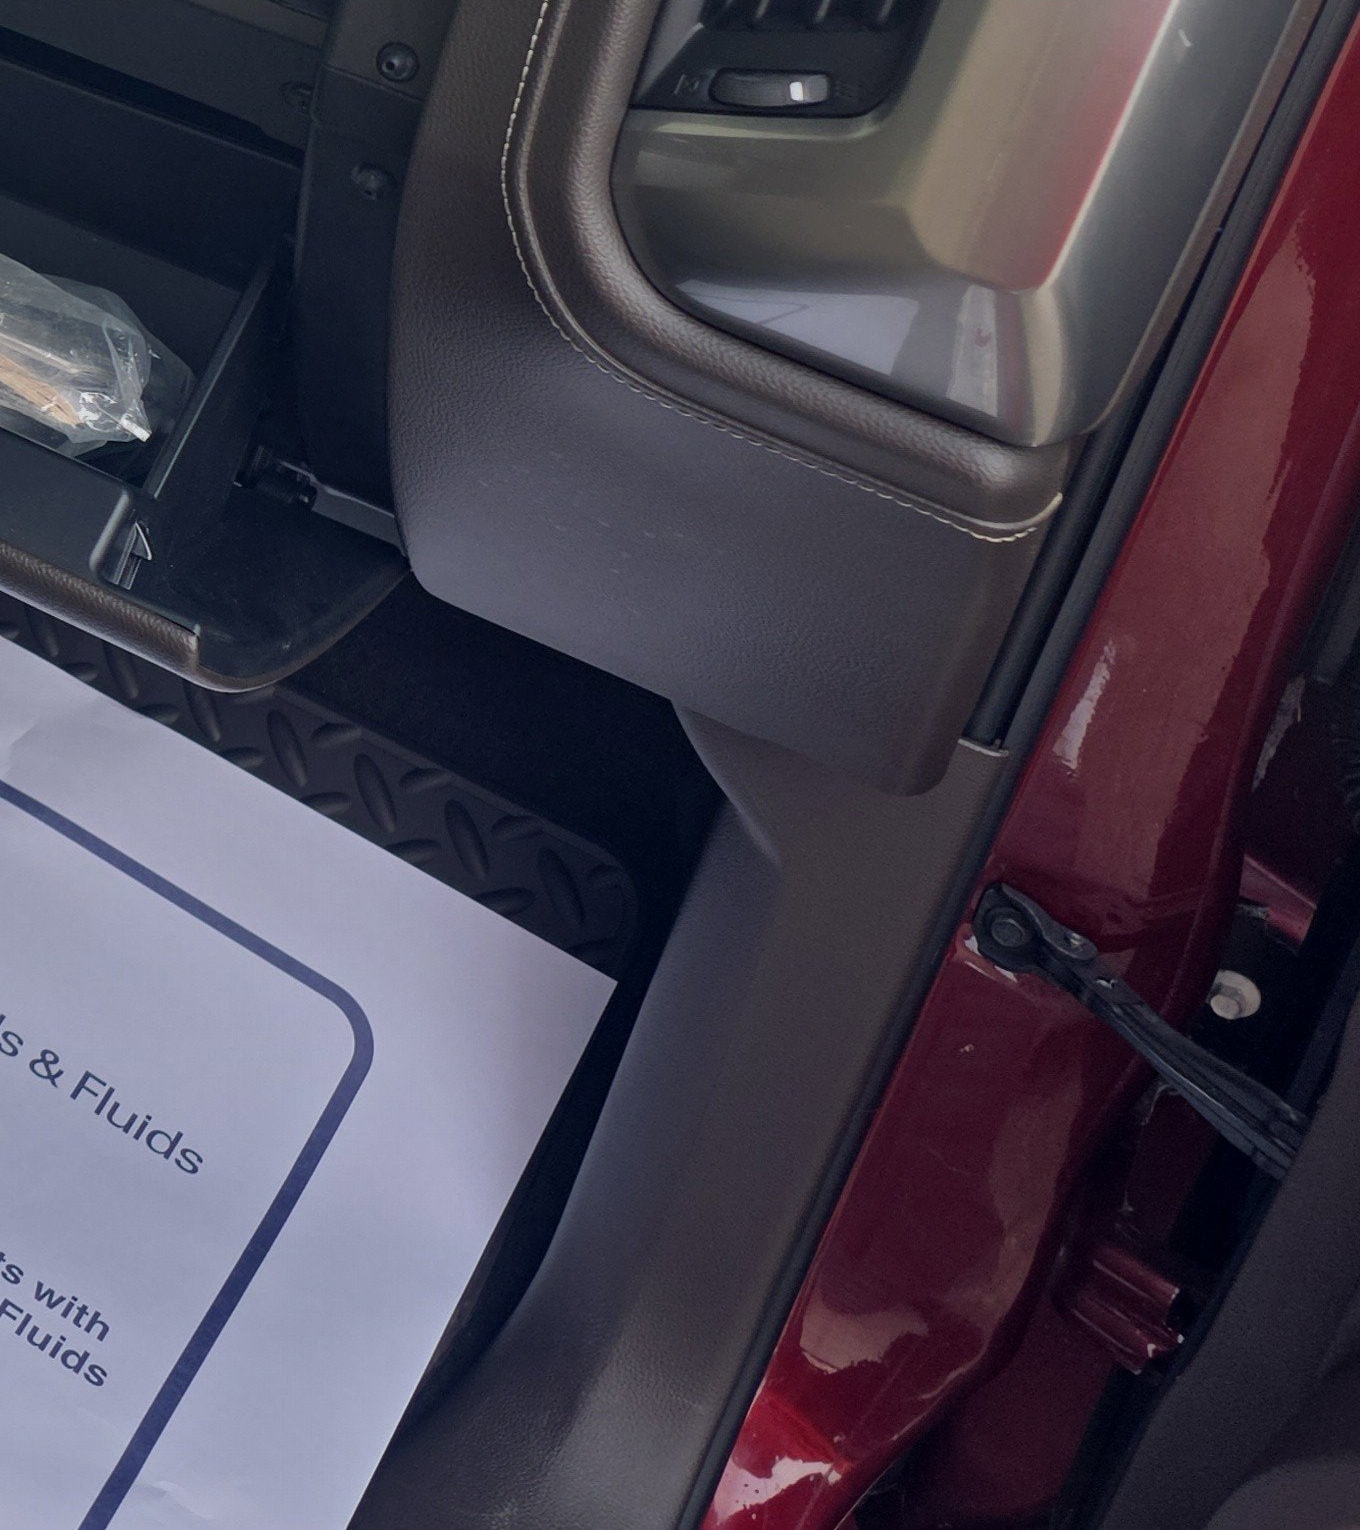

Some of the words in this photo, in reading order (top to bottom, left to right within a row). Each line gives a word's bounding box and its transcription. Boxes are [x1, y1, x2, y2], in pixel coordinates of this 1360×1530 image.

[28, 1048, 64, 1088] &
[69, 1070, 204, 1175] Fluids
[33, 1280, 111, 1342] with
